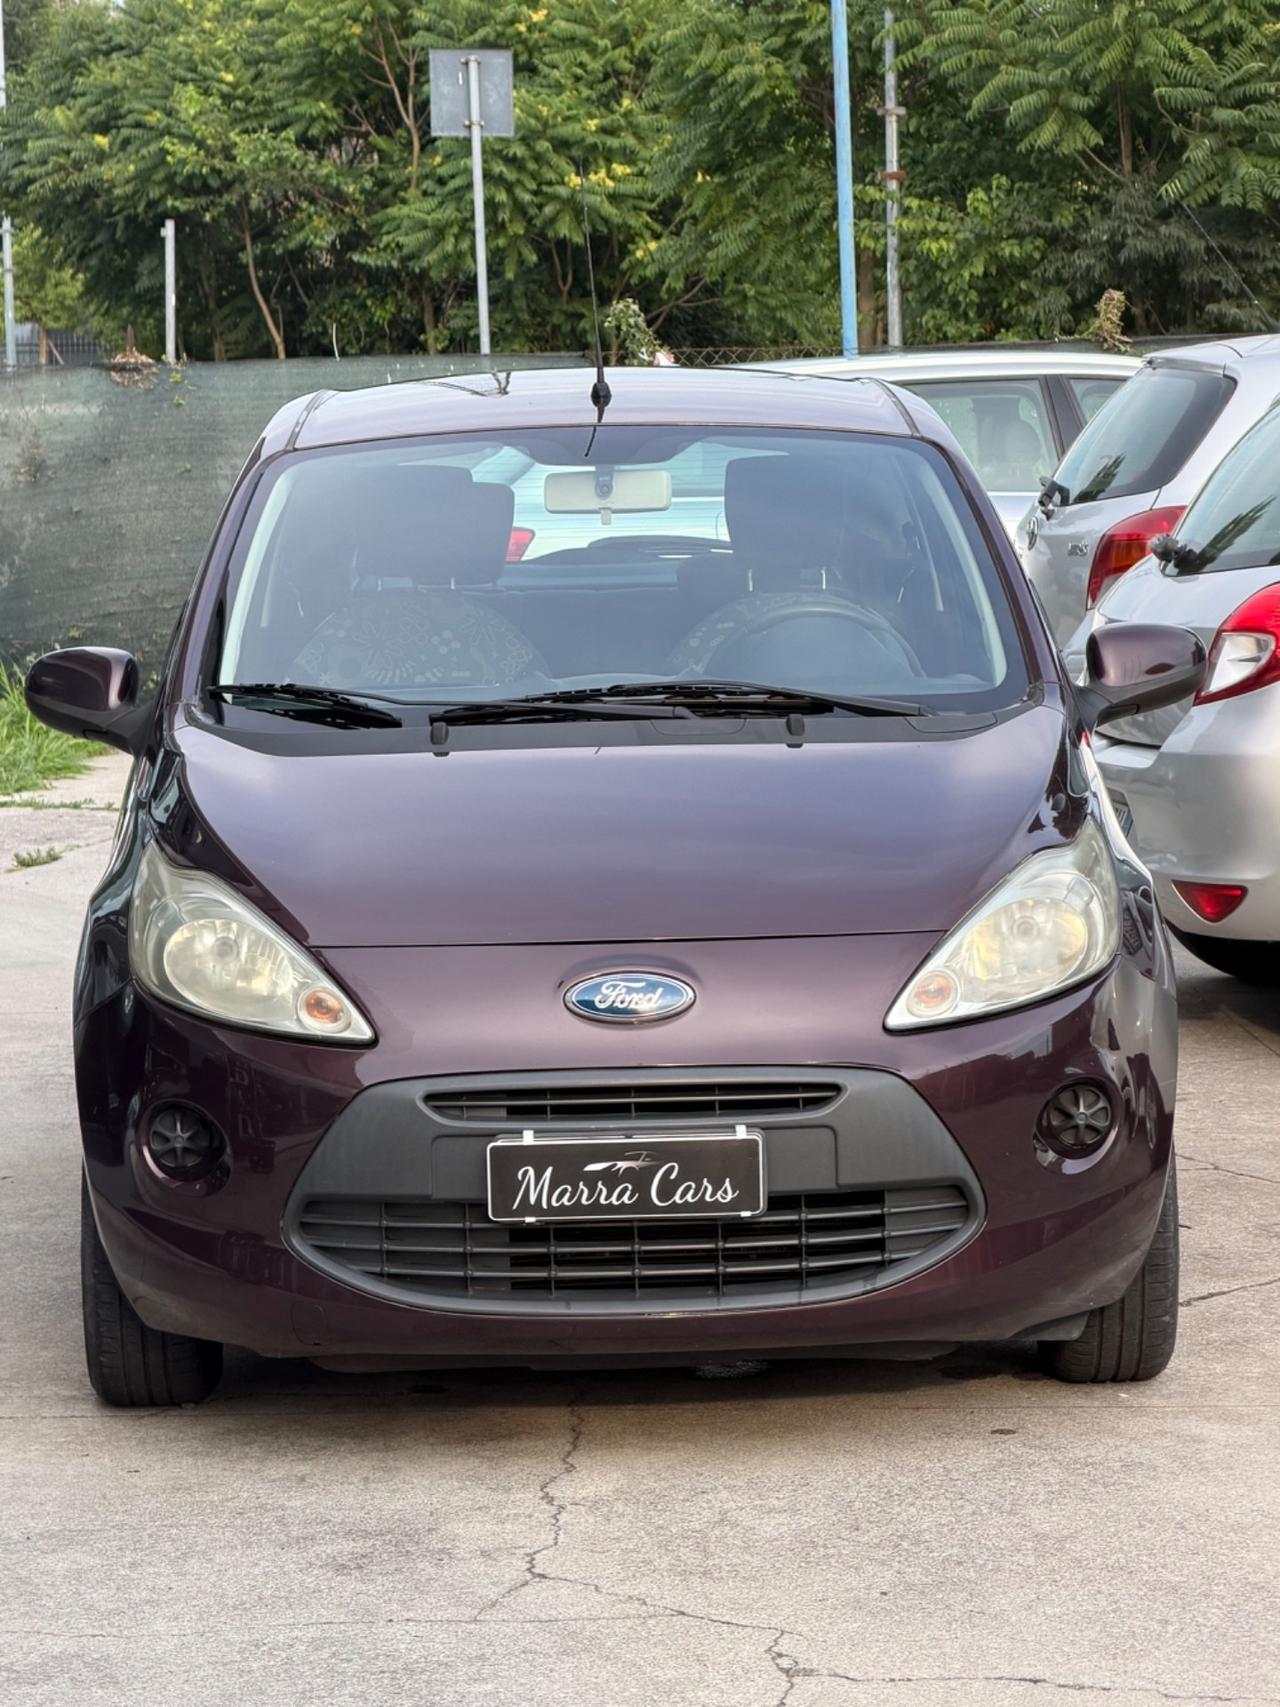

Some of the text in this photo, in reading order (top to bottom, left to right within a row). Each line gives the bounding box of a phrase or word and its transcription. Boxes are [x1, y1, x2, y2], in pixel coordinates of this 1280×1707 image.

[594, 980, 664, 1009] Ford
[511, 1162, 740, 1210] Marra Cars
